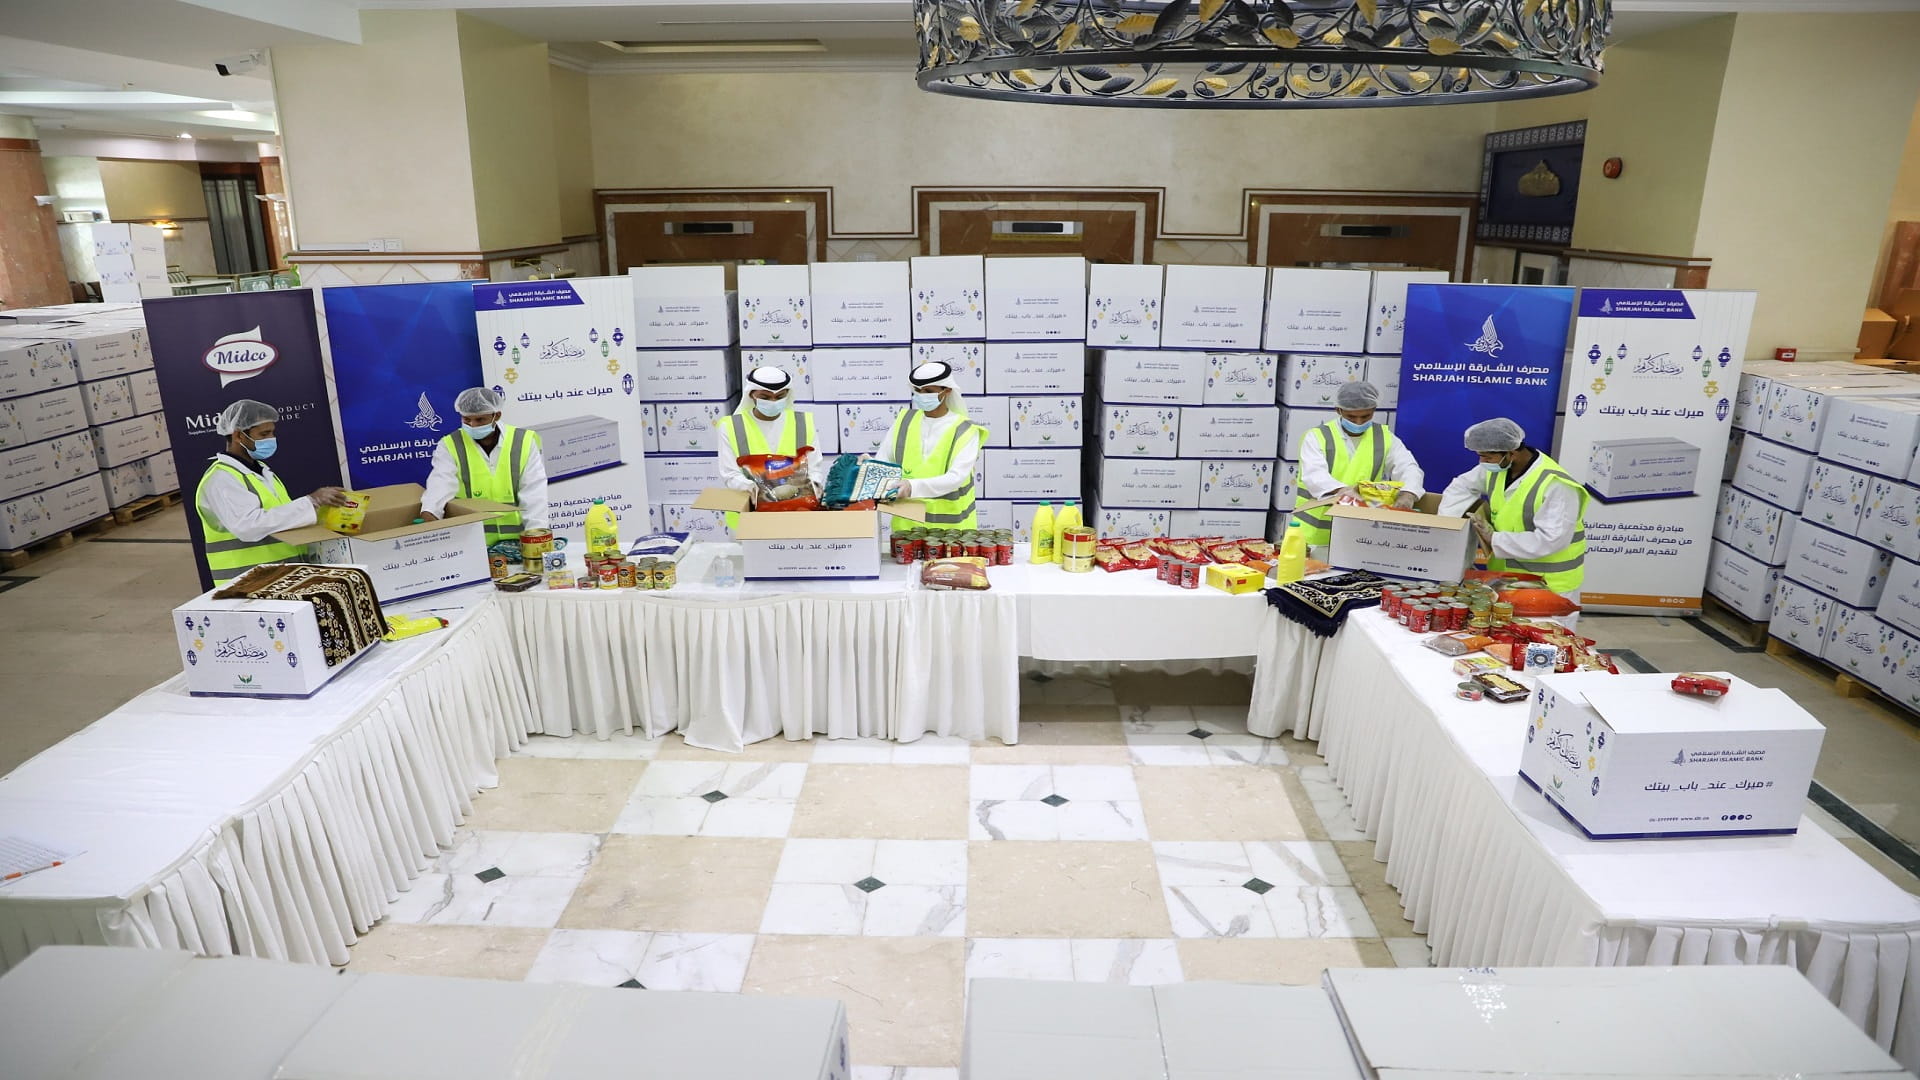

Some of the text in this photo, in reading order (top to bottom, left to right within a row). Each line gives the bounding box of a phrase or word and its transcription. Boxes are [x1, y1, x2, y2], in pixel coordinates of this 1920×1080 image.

[213, 349, 268, 365] Midco
[1413, 362, 1550, 374] مصرف الشارقة الإسلامي
[1412, 373, 1548, 386] SHARJAH ISLAMIC BANK
[517, 386, 613, 402] ميرك عند باب بيتك
[278, 402, 315, 414] ODUCT
[1599, 405, 1704, 419] ميرك عند باب بيتك
[185, 412, 222, 430] Mid
[281, 413, 301, 421] IDE
[360, 440, 411, 454] الإسلامي
[361, 452, 412, 465] SHARJAH
[1618, 523, 1654, 531] مجتمعية
[1656, 524, 1684, 533] مبادرة
[1612, 534, 1644, 543] الشارقة
[1678, 537, 1692, 545] من
